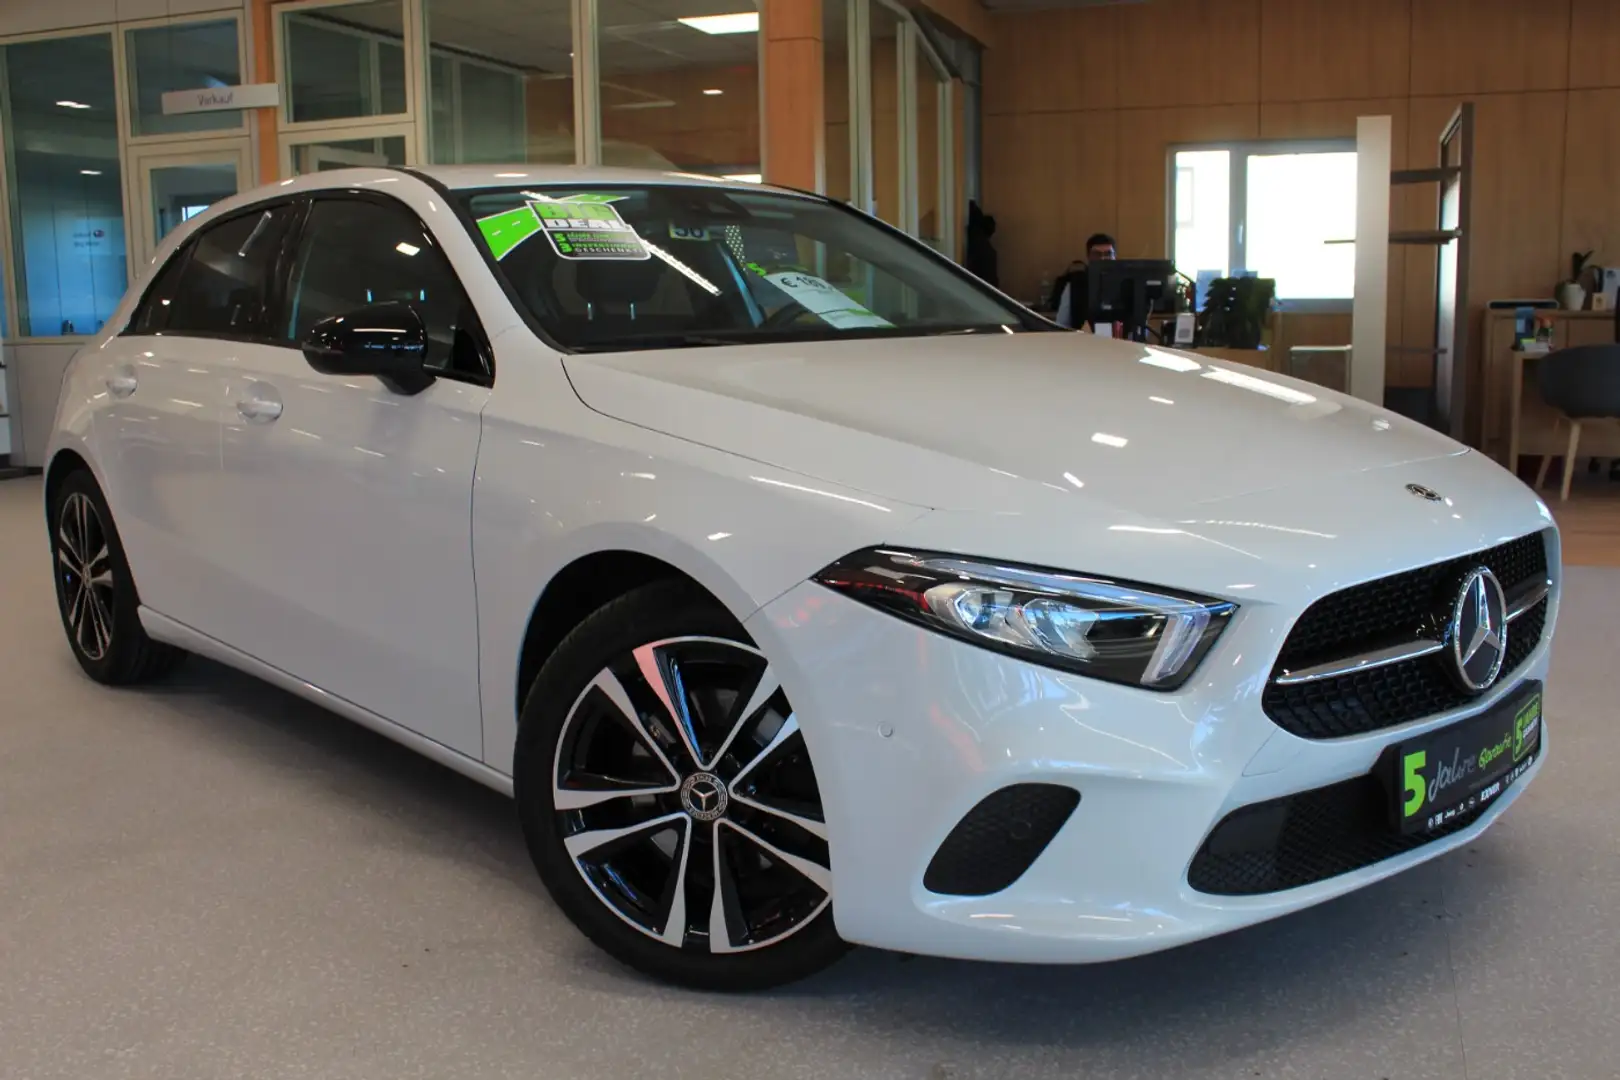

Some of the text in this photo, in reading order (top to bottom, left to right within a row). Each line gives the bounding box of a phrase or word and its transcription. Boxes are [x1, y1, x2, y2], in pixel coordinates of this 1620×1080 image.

[197, 91, 233, 106] Verkauf
[533, 202, 619, 220] BIG
[543, 218, 626, 229] DEAL
[1404, 750, 1427, 818] 5
